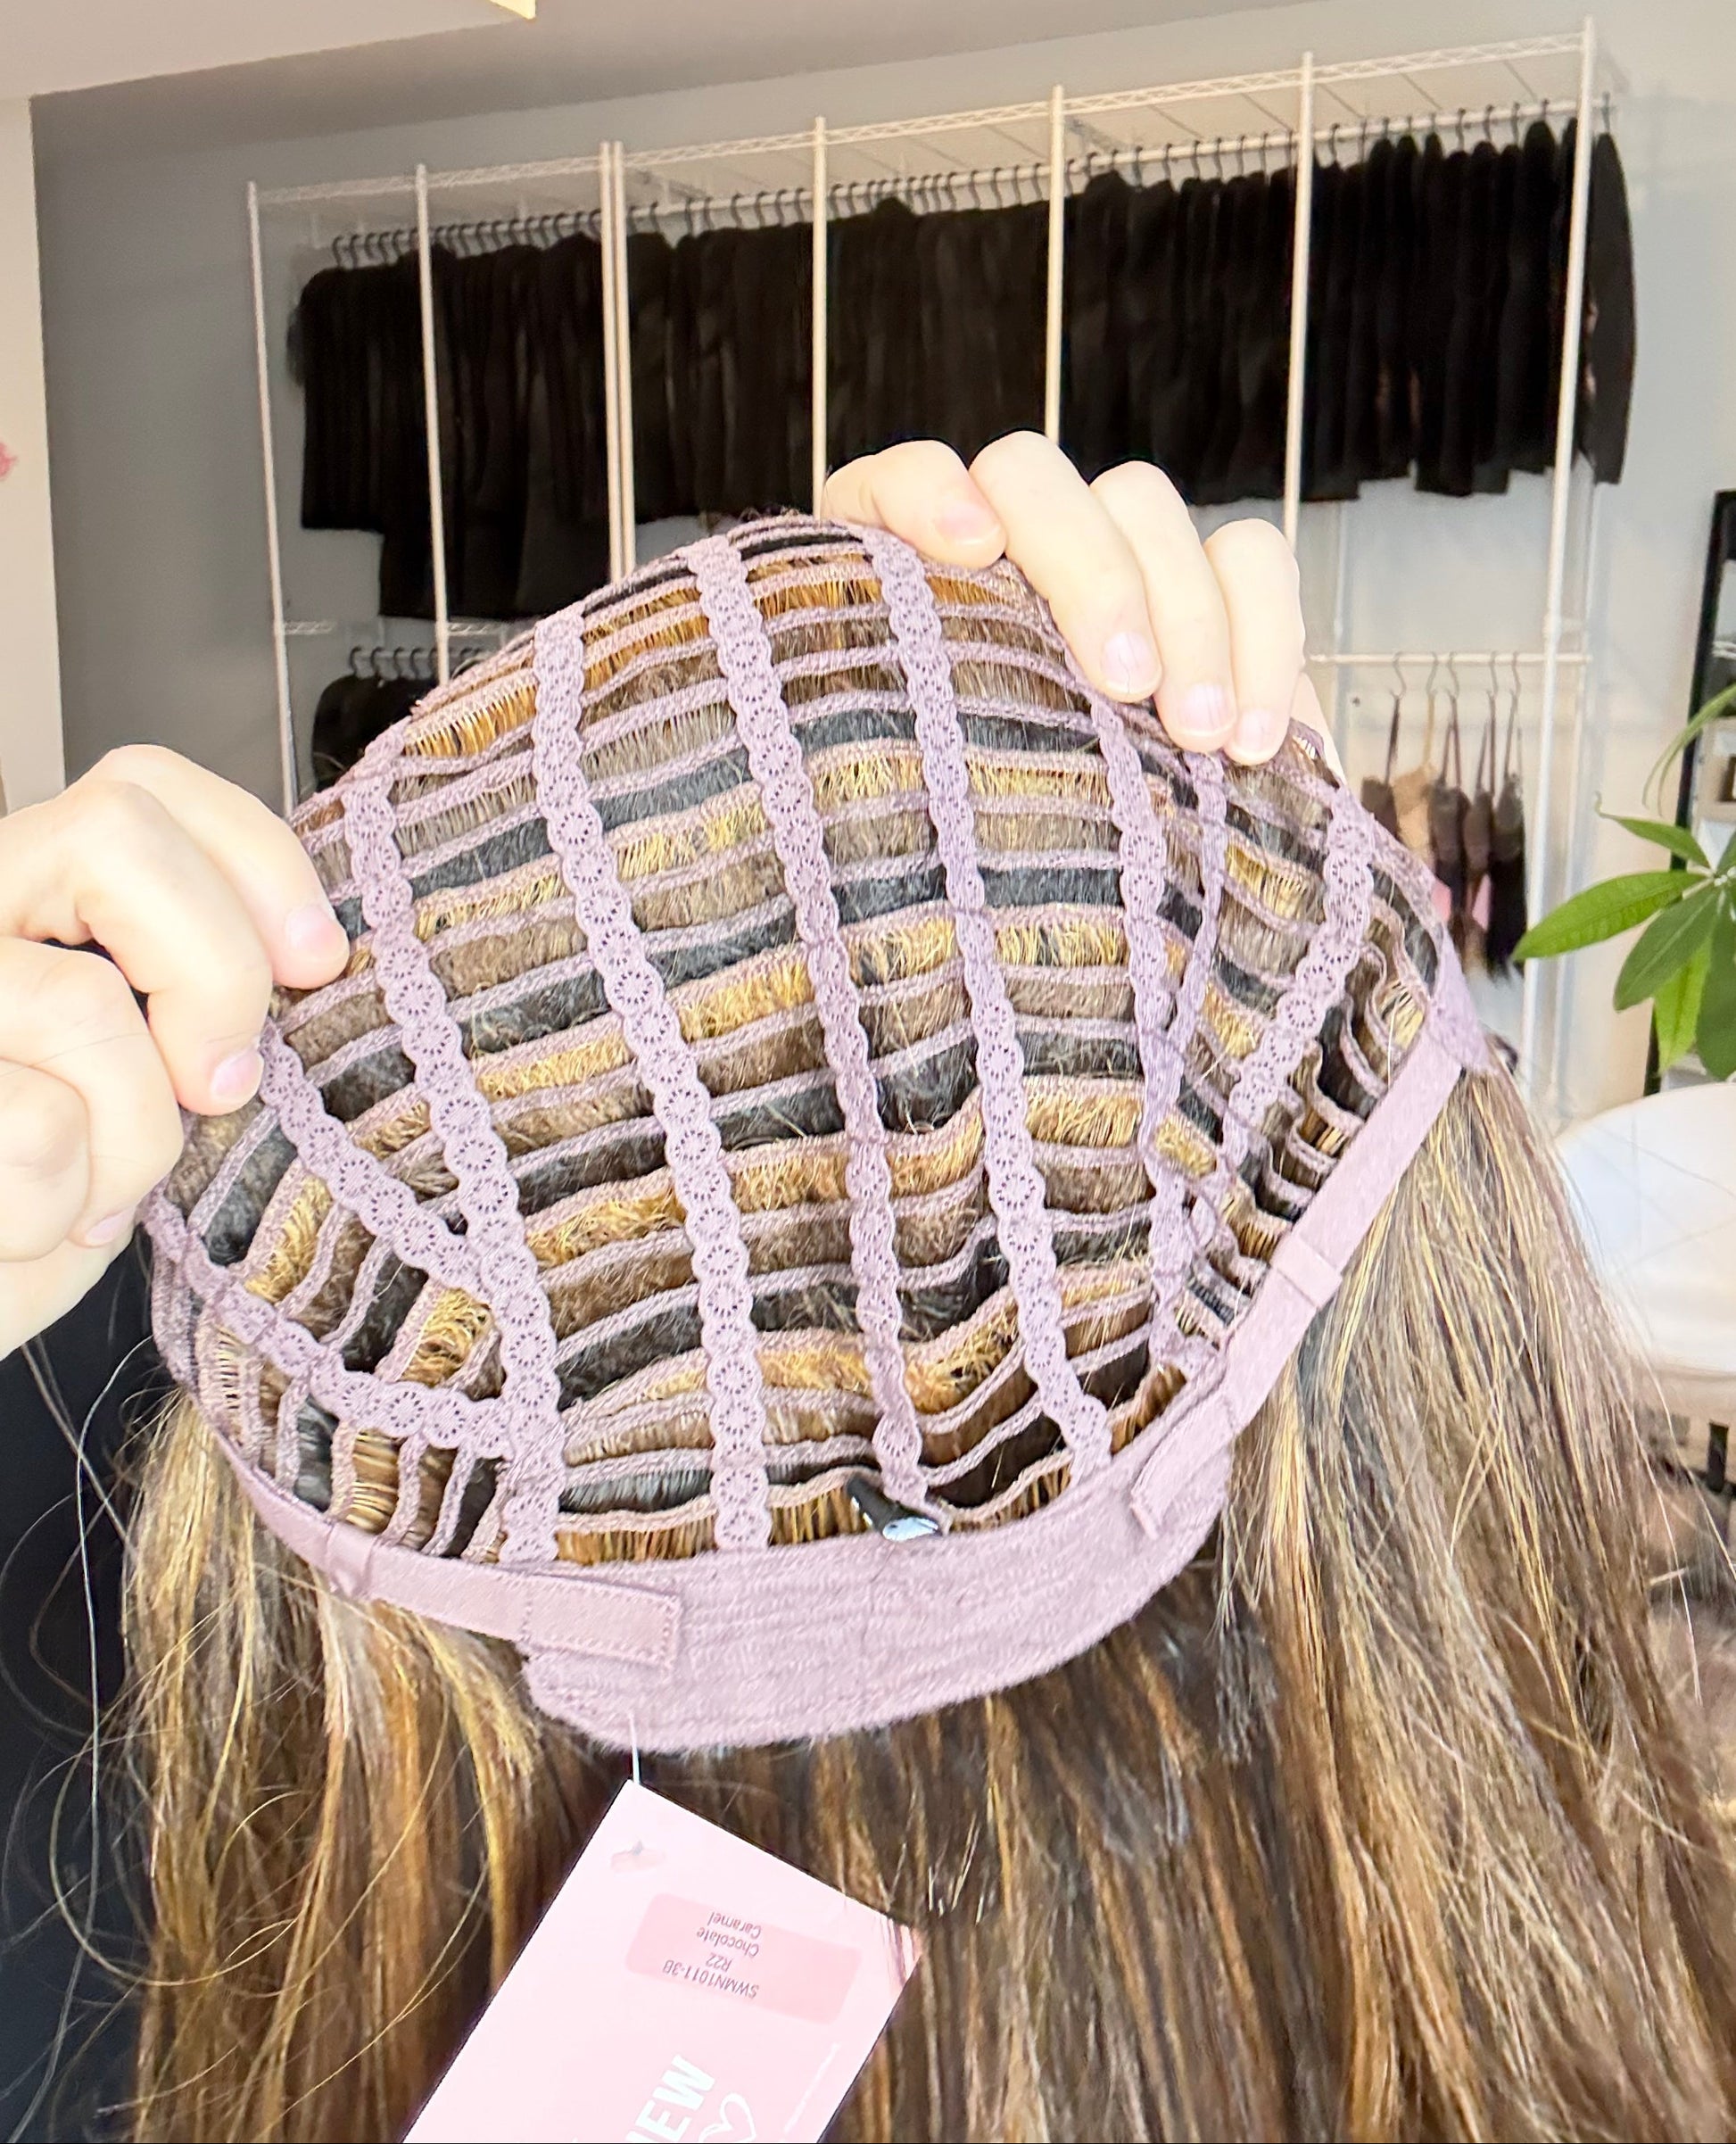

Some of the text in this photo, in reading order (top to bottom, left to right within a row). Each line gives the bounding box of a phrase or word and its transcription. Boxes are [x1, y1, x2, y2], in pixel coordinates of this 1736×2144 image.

[707, 1911, 762, 1940] Caramel
[696, 1926, 759, 1958] Chocolate
[706, 1952, 733, 1972] R22
[625, 2054, 715, 2142] EW
